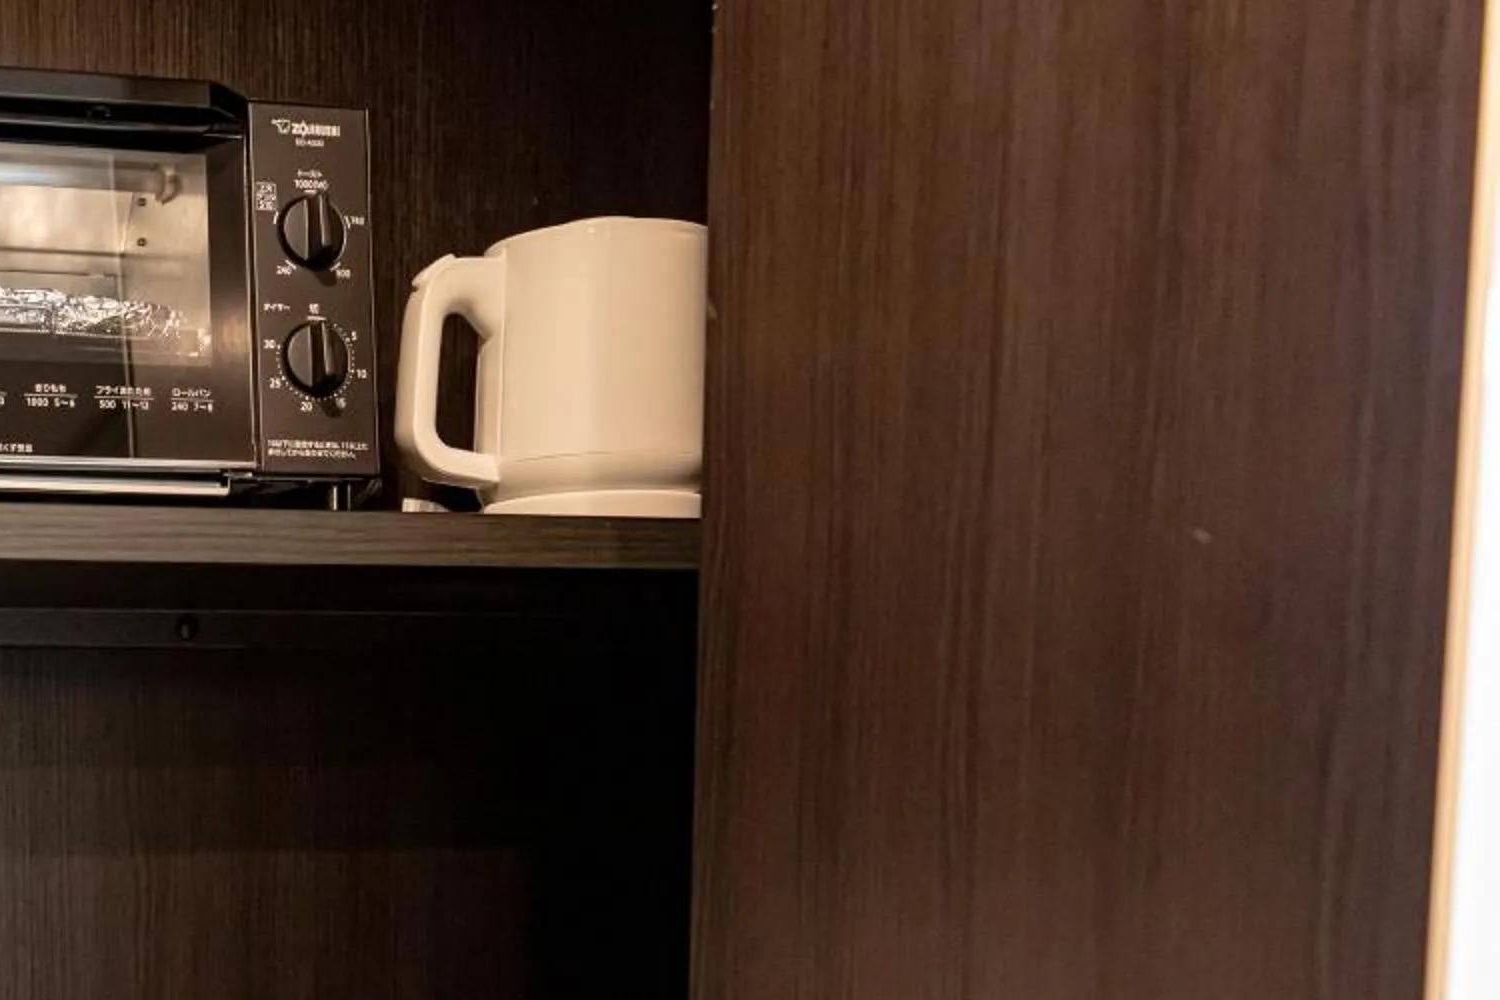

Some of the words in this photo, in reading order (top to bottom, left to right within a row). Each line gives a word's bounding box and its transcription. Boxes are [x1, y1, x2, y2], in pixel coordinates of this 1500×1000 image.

[351, 331, 357, 341] 5
[356, 369, 368, 379] 10
[269, 378, 281, 388] 25
[300, 402, 313, 412] 20
